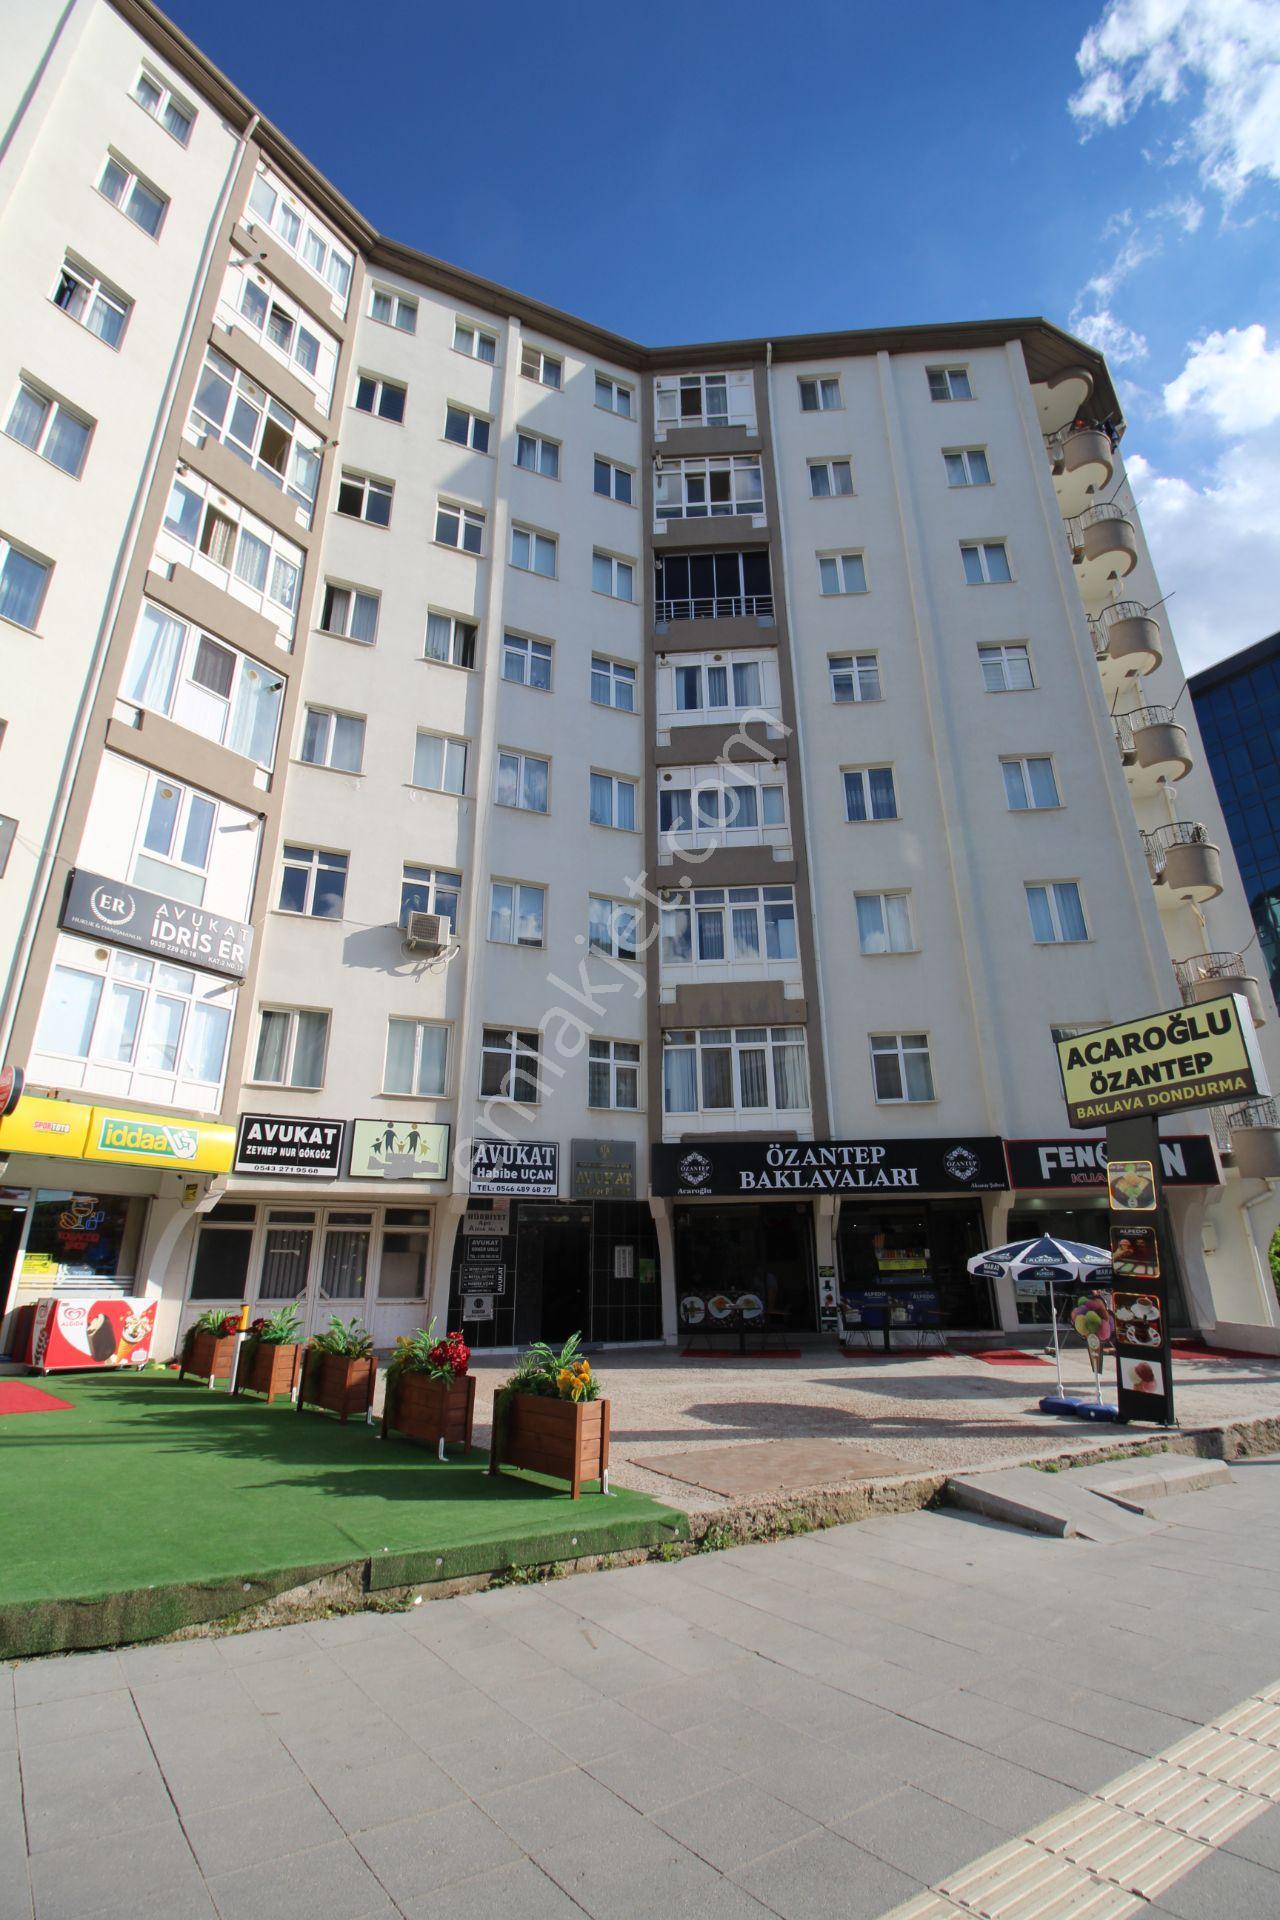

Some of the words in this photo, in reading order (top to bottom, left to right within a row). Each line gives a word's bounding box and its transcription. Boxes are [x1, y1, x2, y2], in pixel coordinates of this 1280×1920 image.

[100, 894, 125, 914] ER
[156, 903, 249, 943] AVUKAT
[151, 914, 212, 953] İDRİS
[218, 939, 244, 963] ER
[1067, 1008, 1232, 1070] ACAROĞLU
[1090, 1051, 1213, 1095] ÖZANTEP
[1076, 1096, 1144, 1119] BAKLAVA
[1147, 1076, 1247, 1106] DONDURMA
[247, 1123, 338, 1145] AVUKAT
[246, 1145, 277, 1156] ZEYNEP
[280, 1147, 296, 1157] NUR
[299, 1148, 331, 1159] GÖKGÖZ
[474, 1143, 555, 1166] AVUKAT
[766, 1143, 886, 1167] ÖZANTEP
[477, 1167, 518, 1179] Habibe
[520, 1169, 553, 1182] UÇAN
[739, 1168, 919, 1189] BAKLAVALARI
